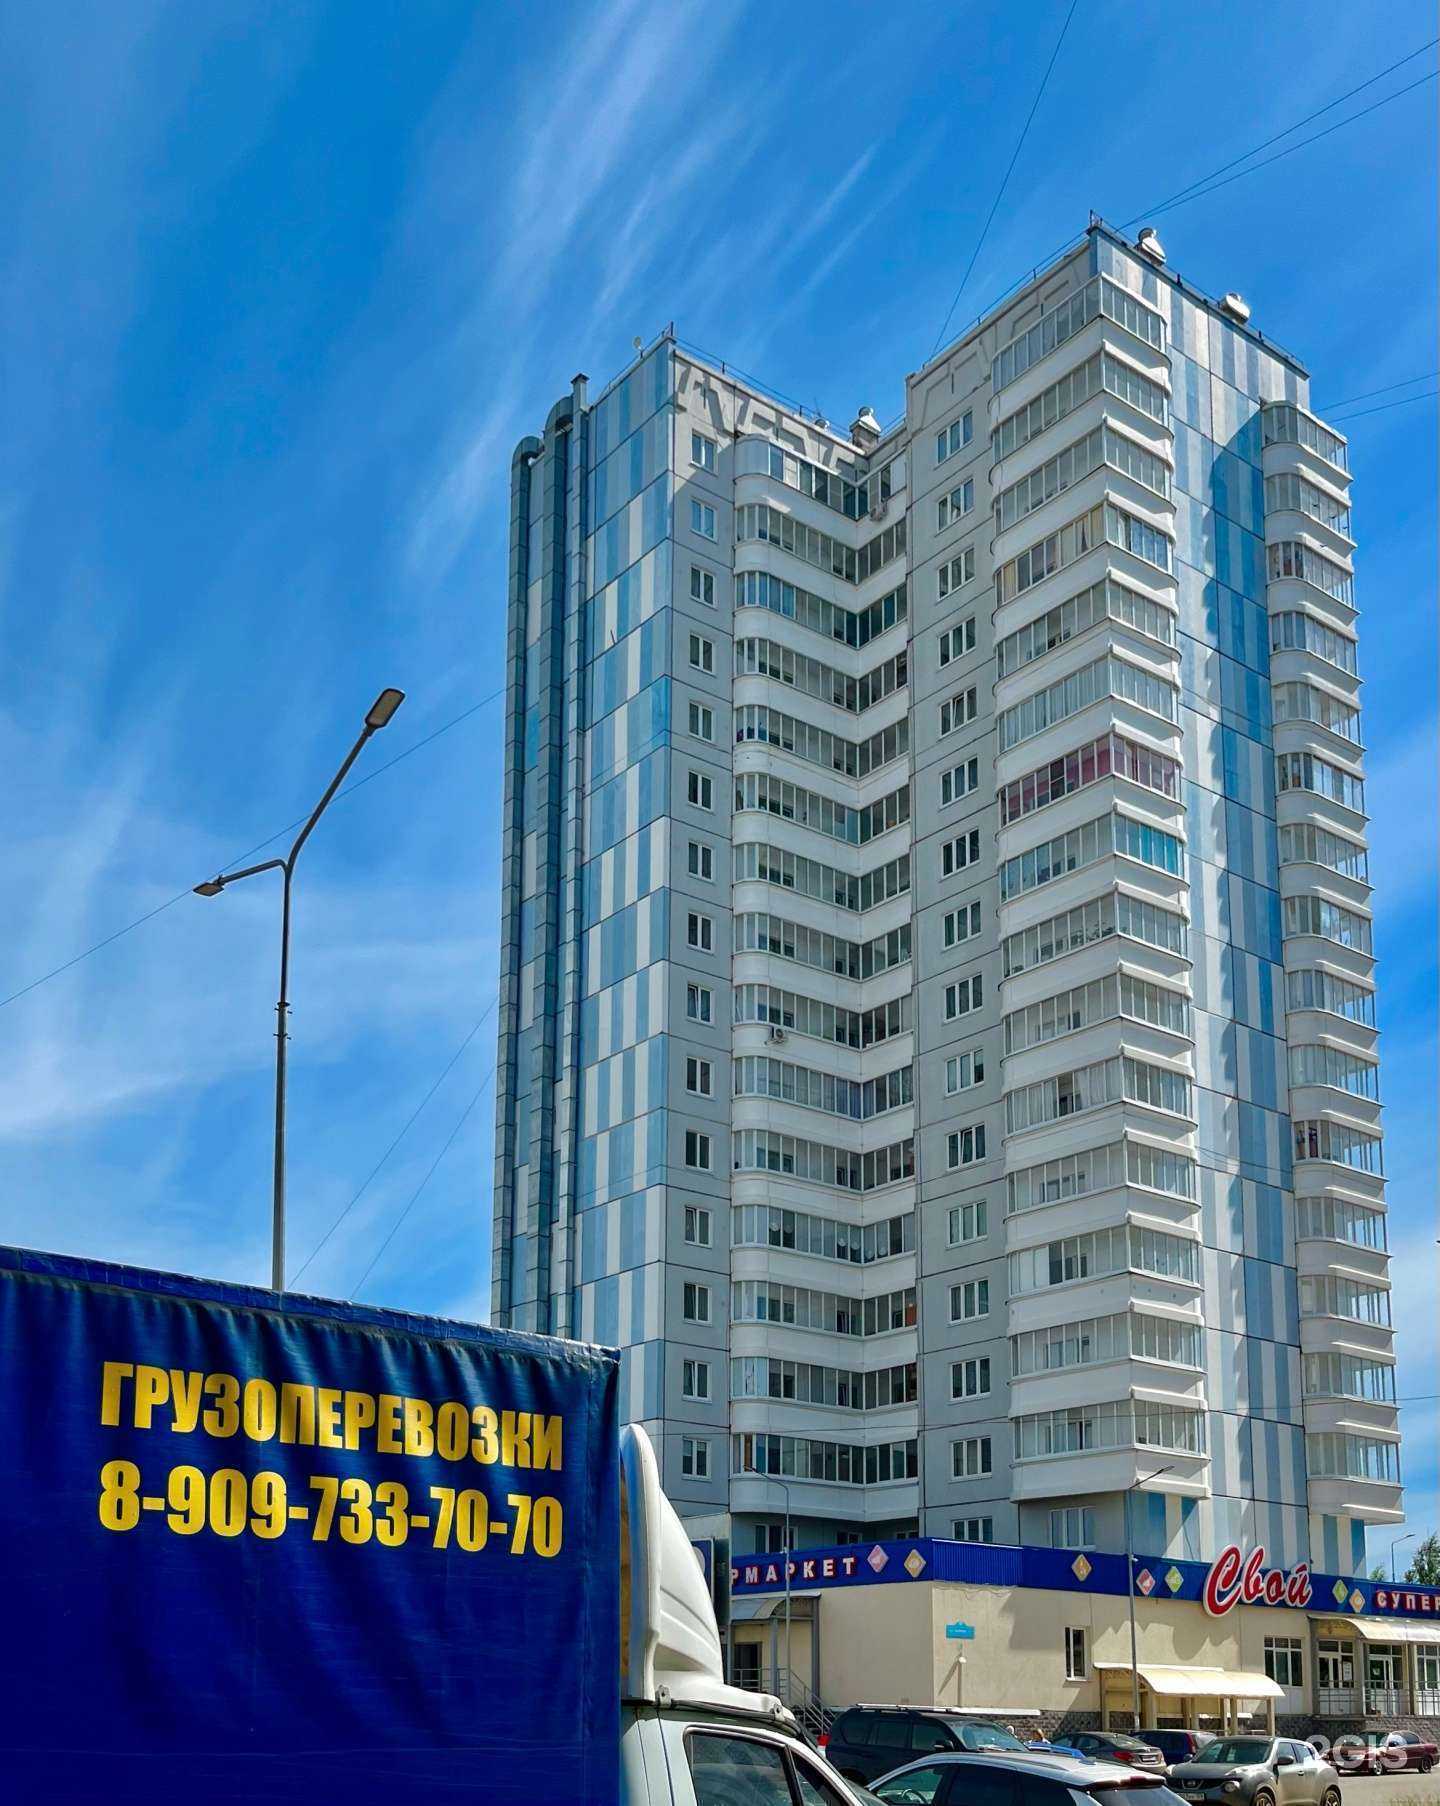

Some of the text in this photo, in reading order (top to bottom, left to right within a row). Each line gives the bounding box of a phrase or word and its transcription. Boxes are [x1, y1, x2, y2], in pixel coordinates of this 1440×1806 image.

[101, 1361, 563, 1471] ГРУЗОПЕРЕВОЗКИ
[99, 1459, 563, 1558] 8-909-733-70-70
[1203, 1544, 1312, 1618] Свой
